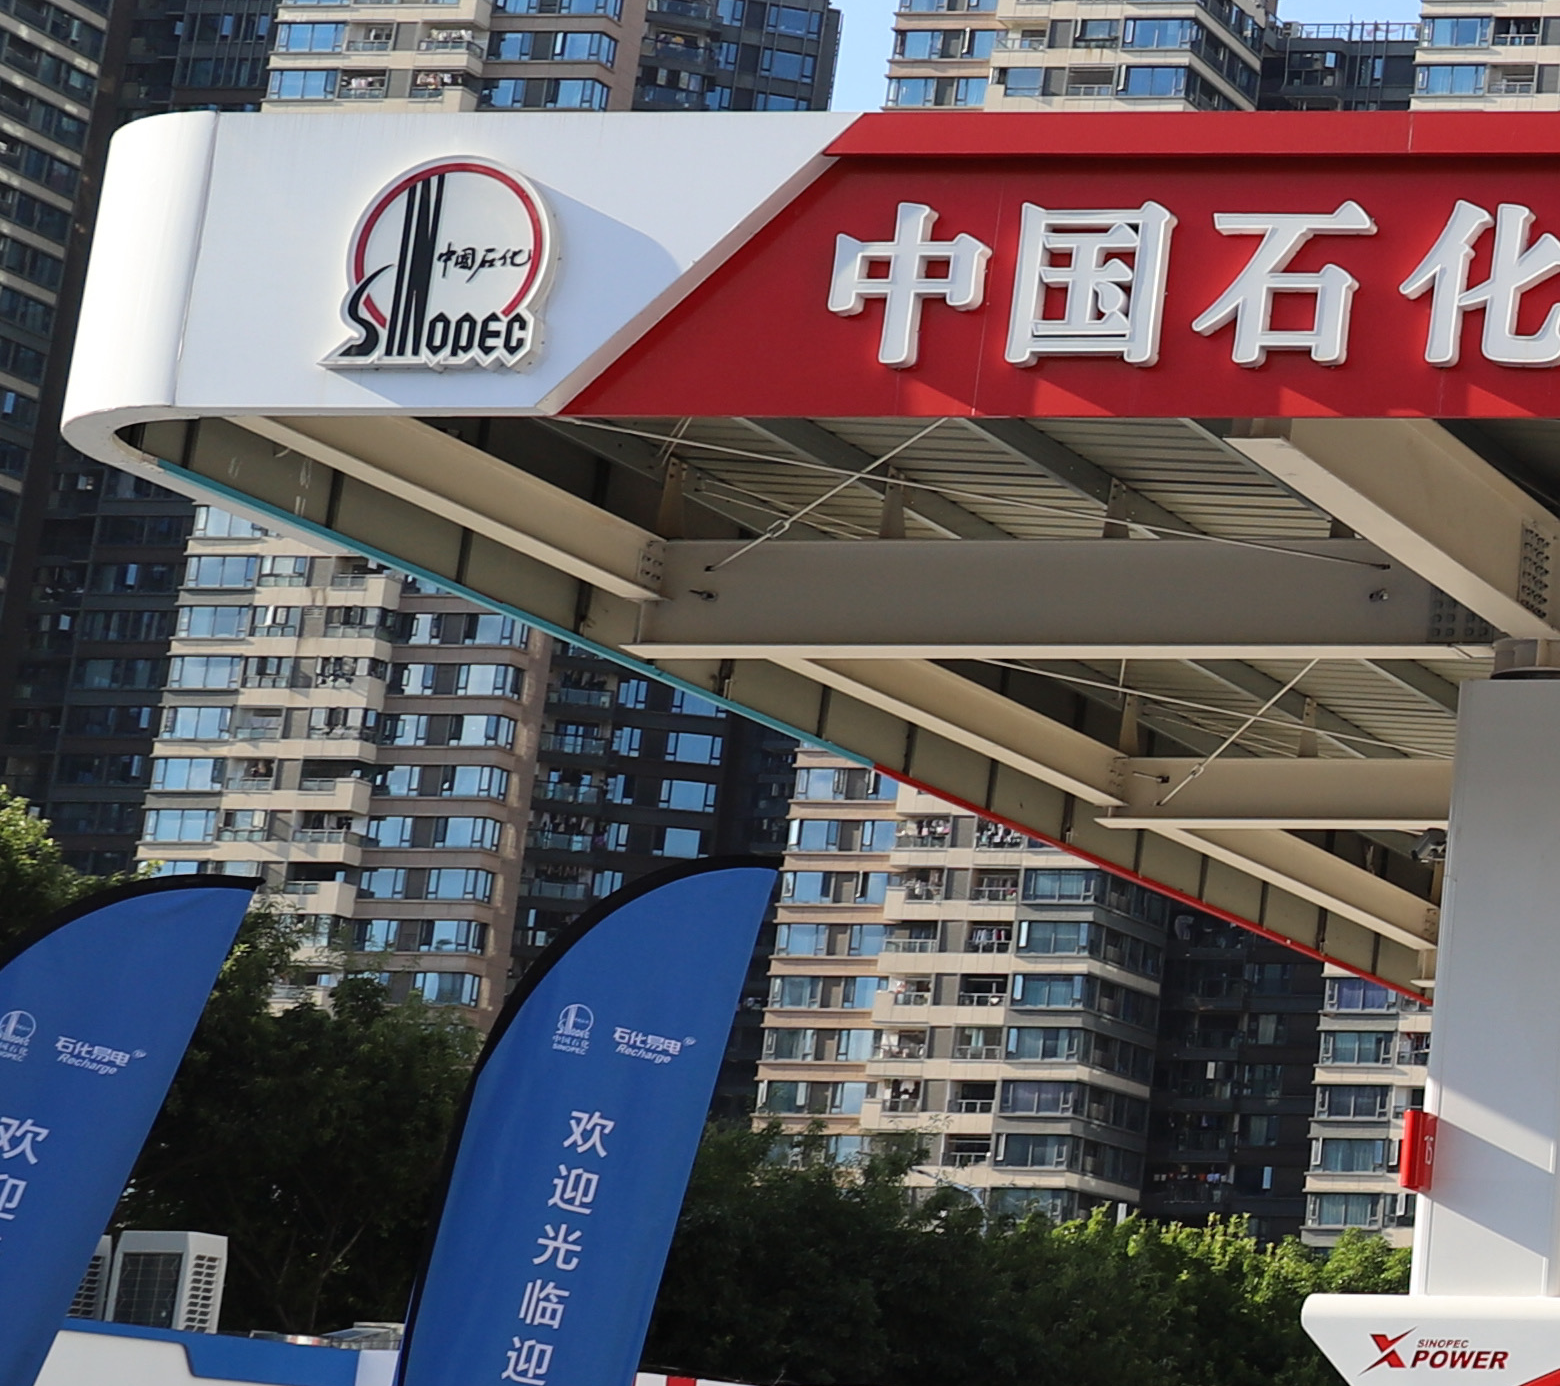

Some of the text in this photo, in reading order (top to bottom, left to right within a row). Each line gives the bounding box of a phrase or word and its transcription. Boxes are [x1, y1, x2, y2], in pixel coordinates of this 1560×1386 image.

[340, 175, 527, 358] SINOPEC
[436, 242, 531, 282] 中国石化
[55, 1035, 131, 1067] 石化易电
[612, 1026, 682, 1055] 石化易电
[57, 1053, 118, 1075] Recharge
[615, 1043, 672, 1064] Recharge
[1417, 1338, 1469, 1348] SINOPEC
[1410, 1350, 1509, 1370] POWER
